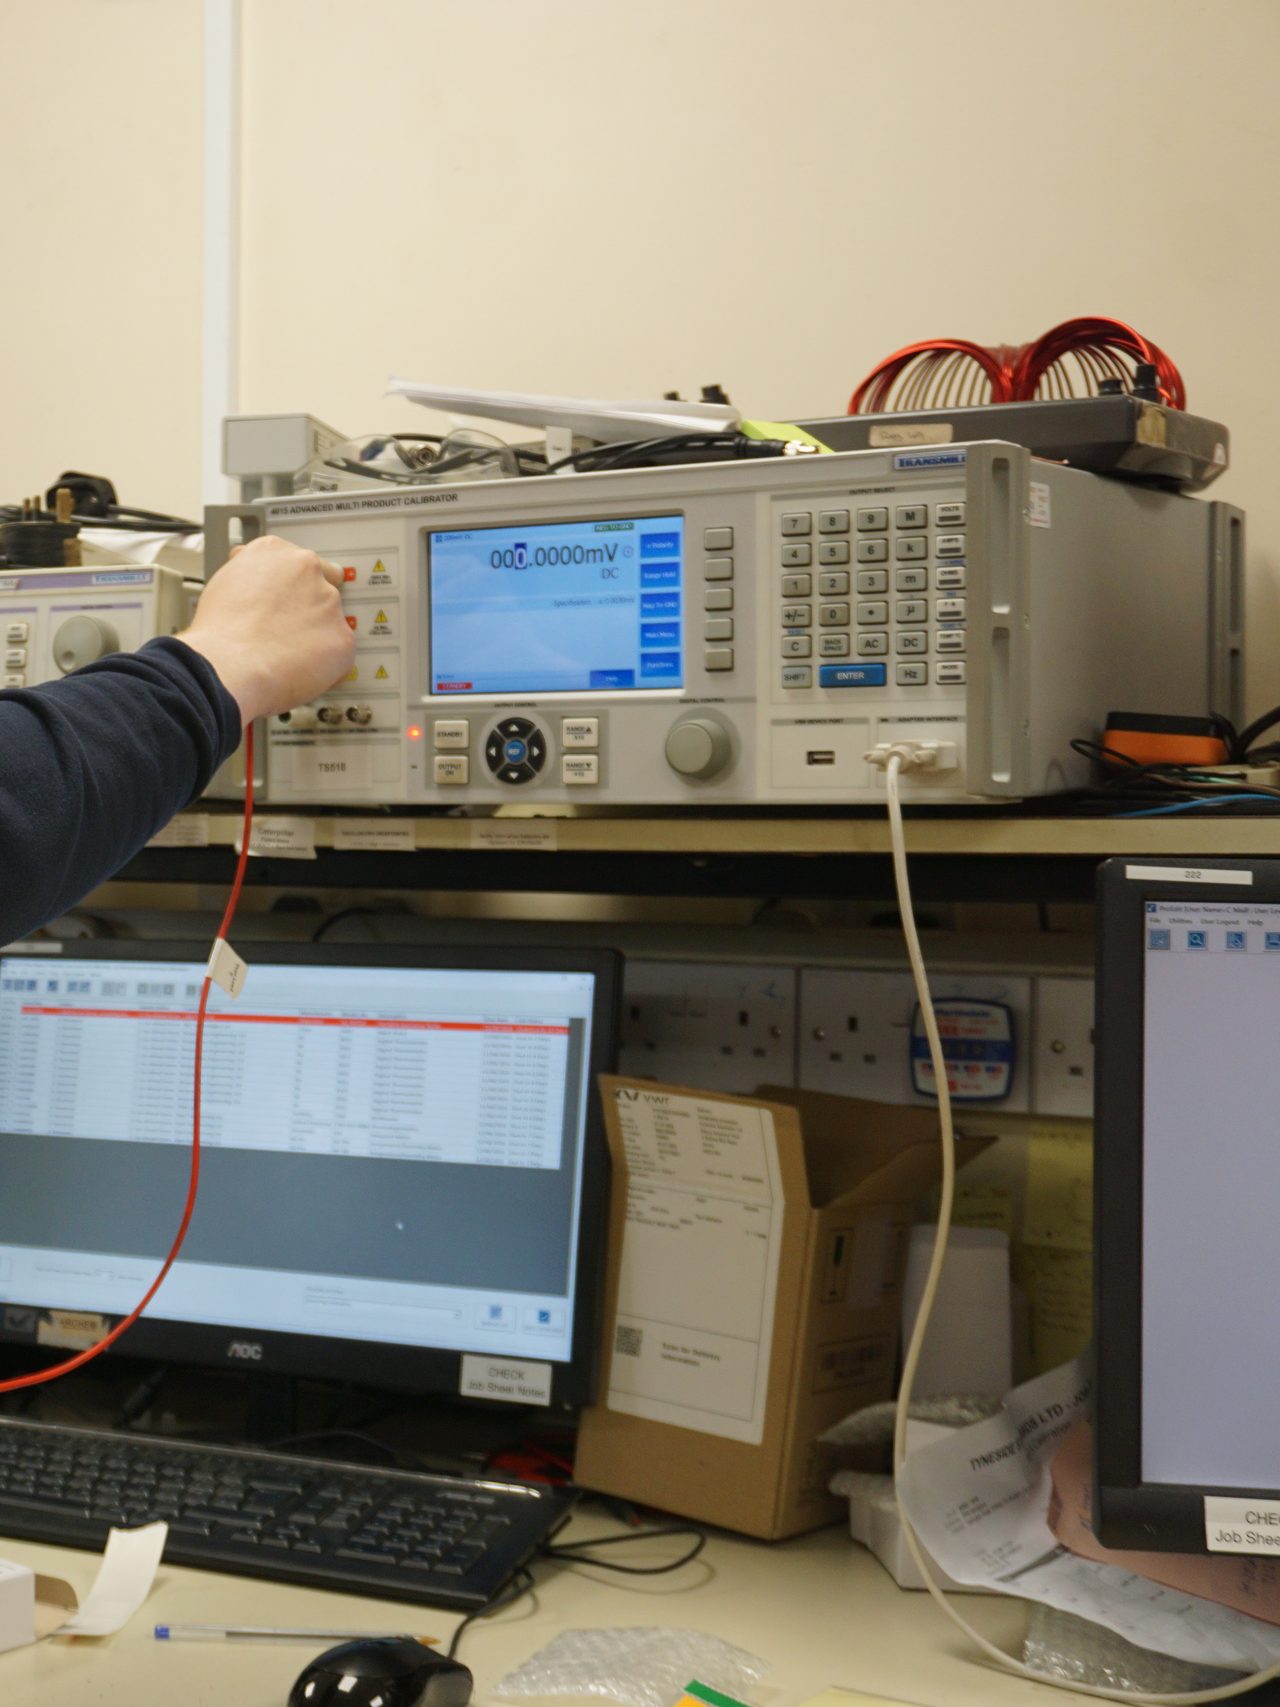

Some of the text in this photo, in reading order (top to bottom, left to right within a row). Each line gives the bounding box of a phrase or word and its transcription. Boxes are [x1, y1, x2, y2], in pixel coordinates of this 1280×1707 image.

[290, 503, 334, 515] ADVANCED
[336, 501, 360, 512] MULTI
[362, 499, 401, 510] PRODUCT
[404, 493, 459, 506] CALIBRATOR
[791, 520, 798, 529] 7
[829, 516, 837, 526] 8
[867, 514, 875, 524] 9
[905, 511, 916, 522] M
[490, 543, 618, 570] 000.0000mV
[791, 550, 798, 559] 4
[829, 547, 837, 557] 5
[867, 545, 875, 555] 6
[907, 543, 915, 553] k
[601, 567, 619, 580] DC
[829, 578, 837, 588] 2
[867, 576, 875, 586] 3
[905, 575, 917, 584] m
[791, 641, 800, 651] C
[864, 639, 879, 649] AC
[903, 638, 919, 648] DC
[784, 673, 806, 682] SHIFT
[836, 671, 865, 680] ENTER
[904, 669, 918, 679] Hz
[1185, 871, 1202, 879] 222
[228, 1341, 264, 1361] AOC
[488, 1367, 526, 1381] CHECK
[466, 1381, 485, 1392] Job
[518, 1385, 546, 1398] Notes
[1039, 1403, 1064, 1424] LTD
[1245, 1510, 1280, 1526] CHE
[1215, 1530, 1242, 1543] Job
